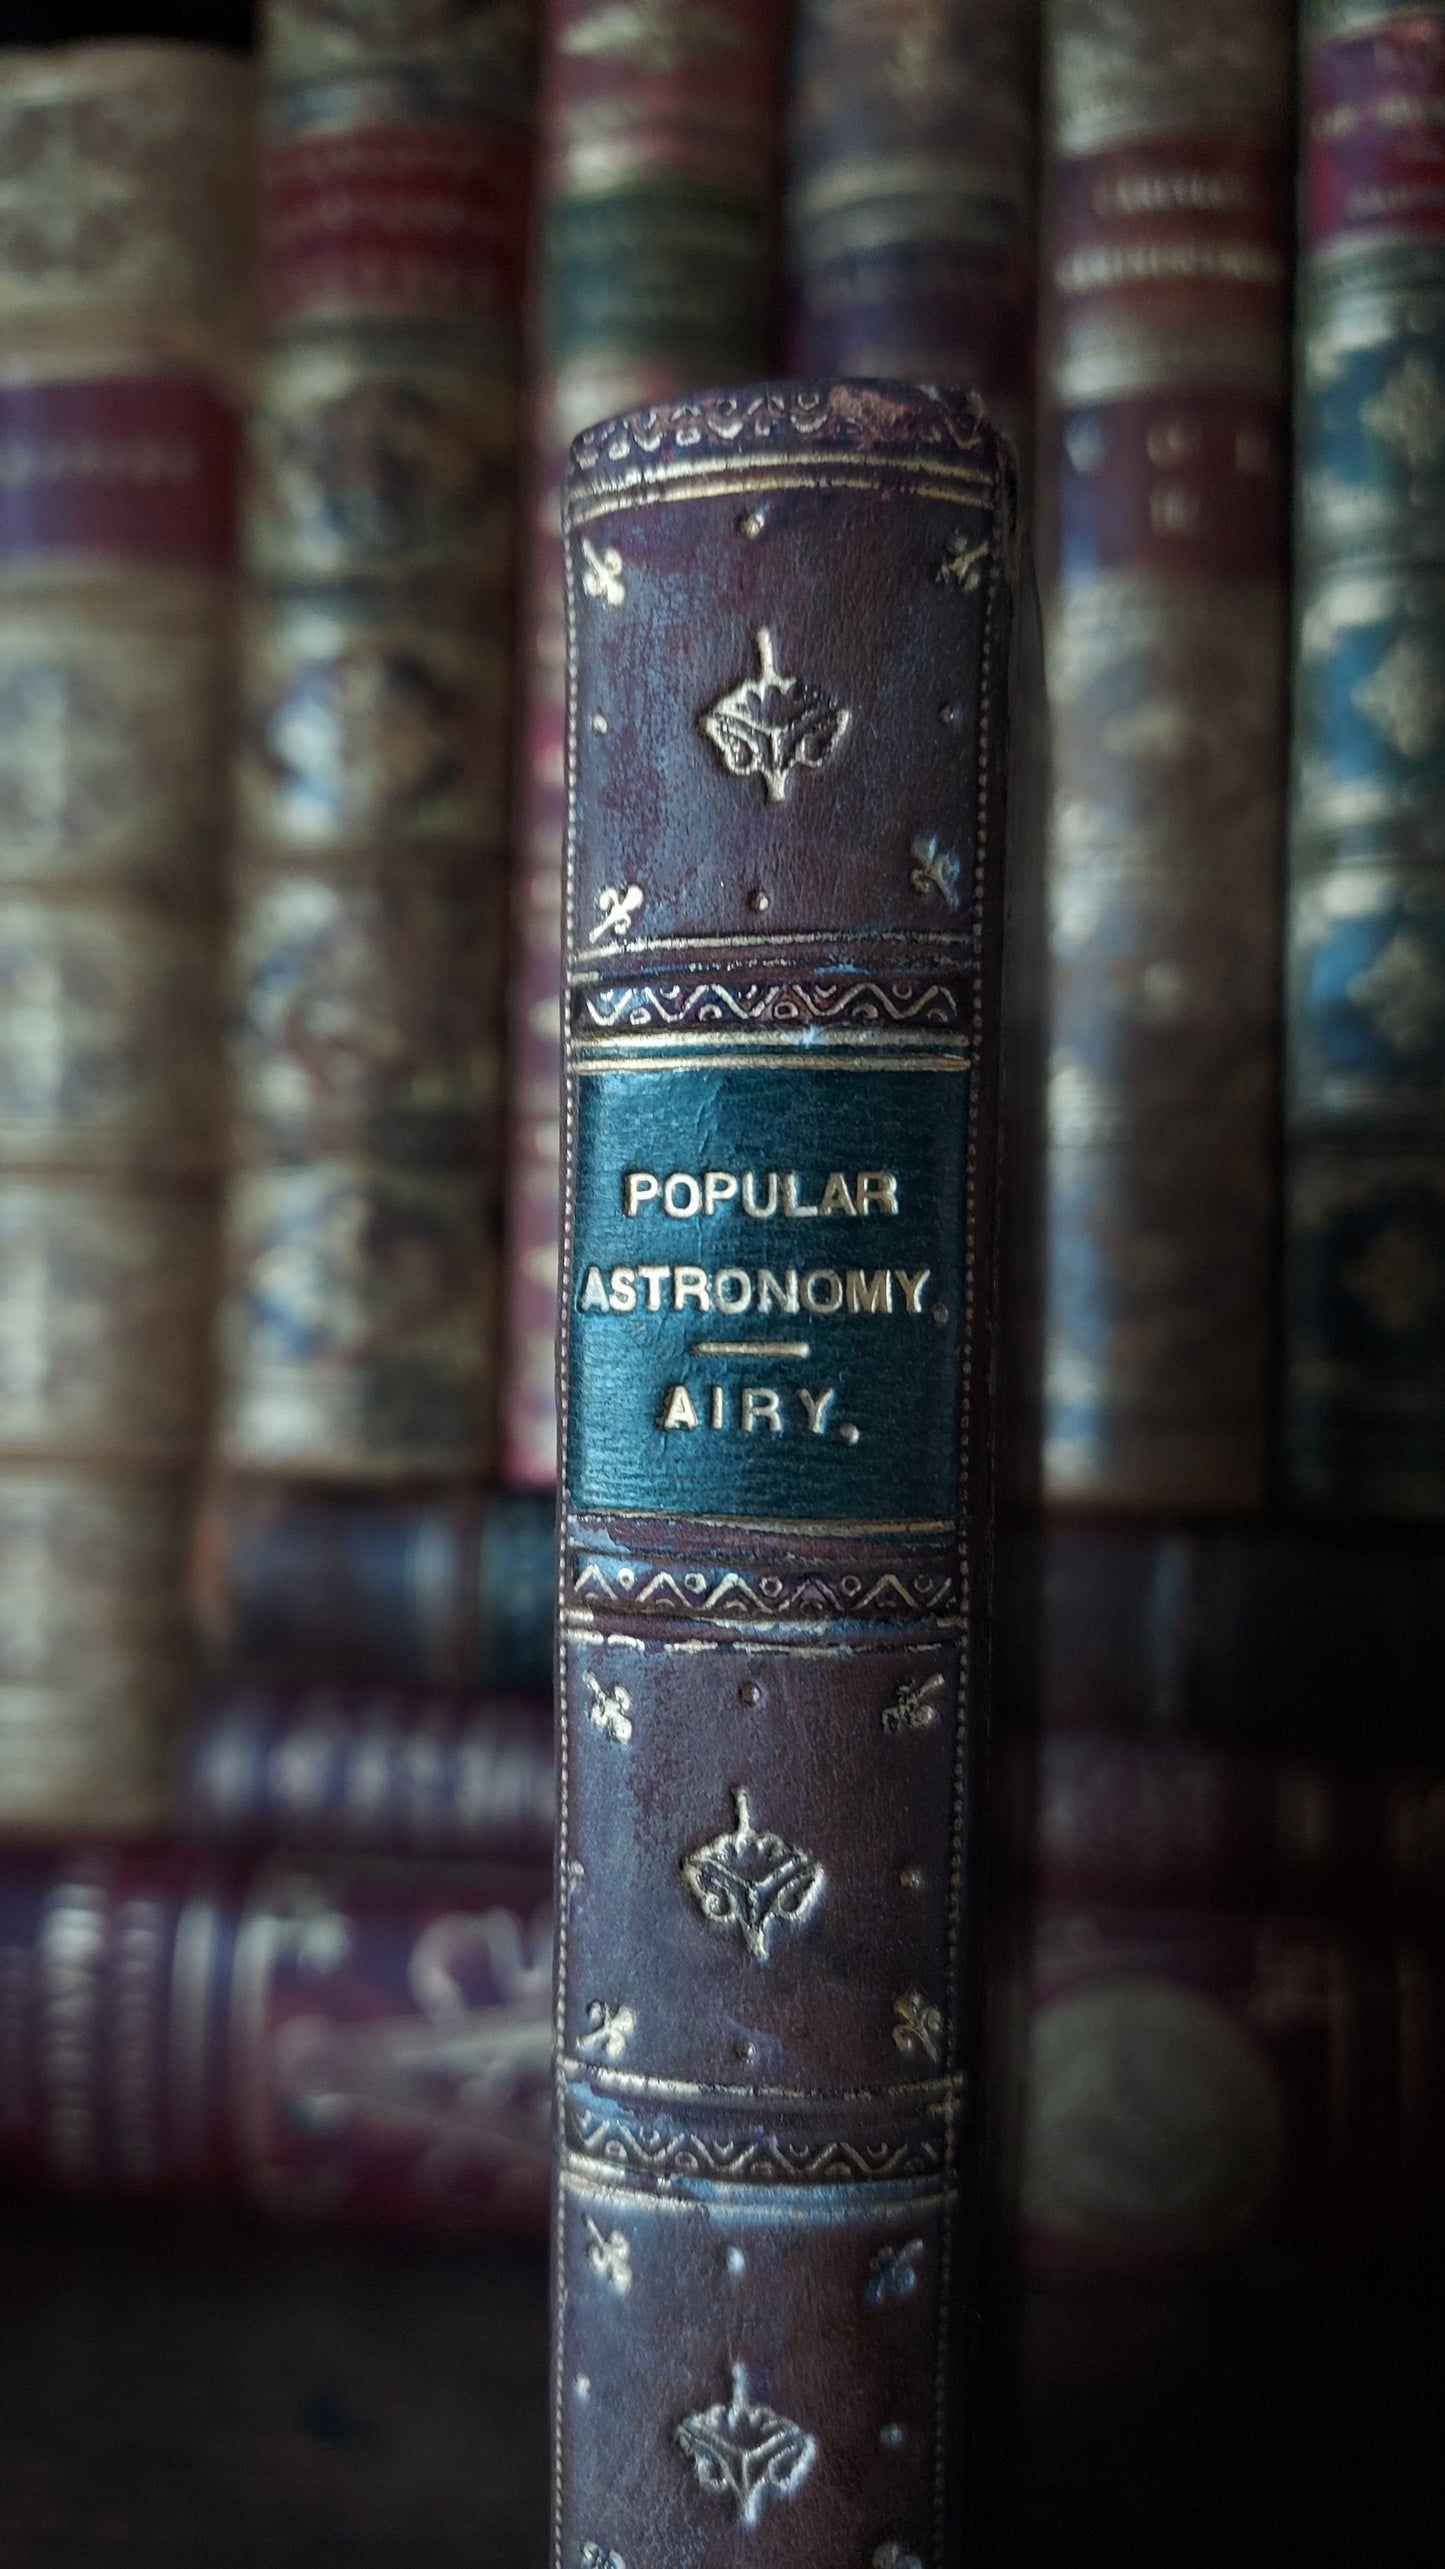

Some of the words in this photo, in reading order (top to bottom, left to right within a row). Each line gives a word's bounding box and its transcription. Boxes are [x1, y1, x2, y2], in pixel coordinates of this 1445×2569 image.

[624, 1171, 899, 1218] POPULAR
[578, 1266, 949, 1325] ASTRONOMY.
[661, 1385, 860, 1445] AIRY.
